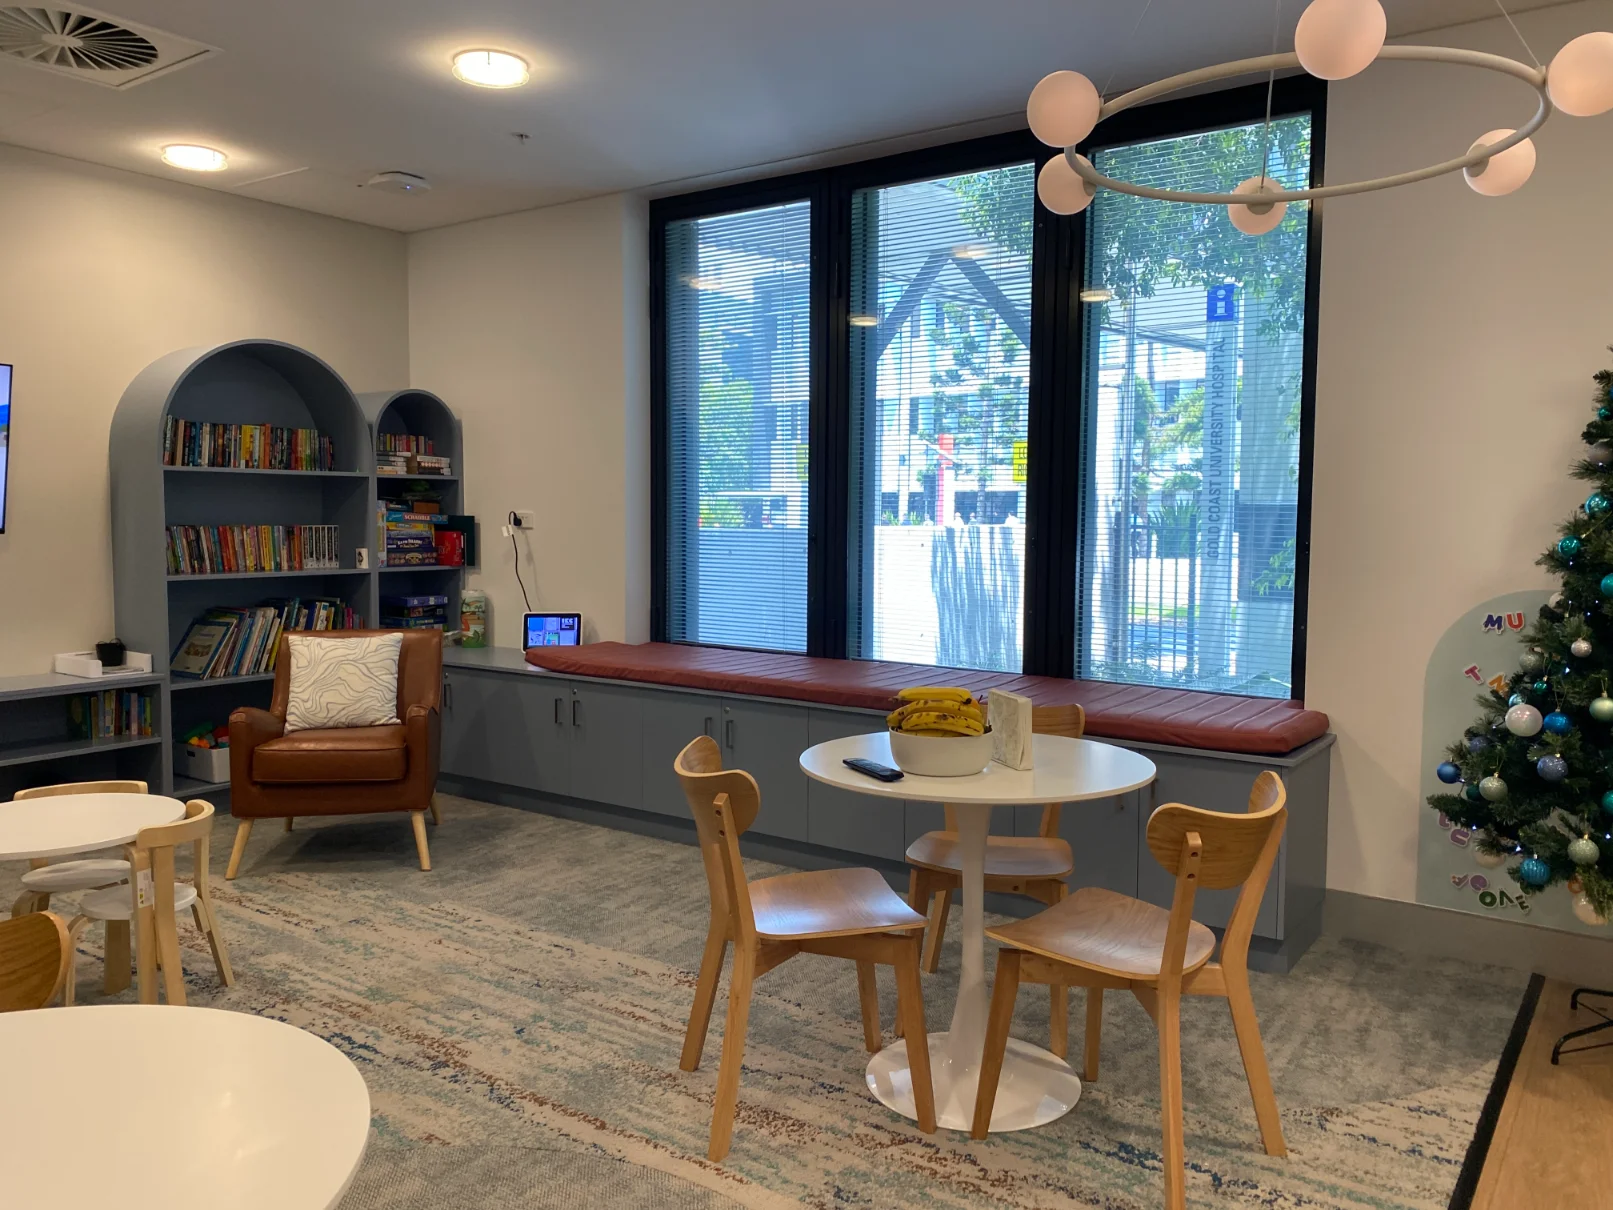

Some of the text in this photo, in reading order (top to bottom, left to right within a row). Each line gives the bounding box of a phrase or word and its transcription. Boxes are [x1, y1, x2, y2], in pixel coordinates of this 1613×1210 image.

[1206, 336, 1225, 559] GOLD COAST UNIVERSITY HOSPITAL
